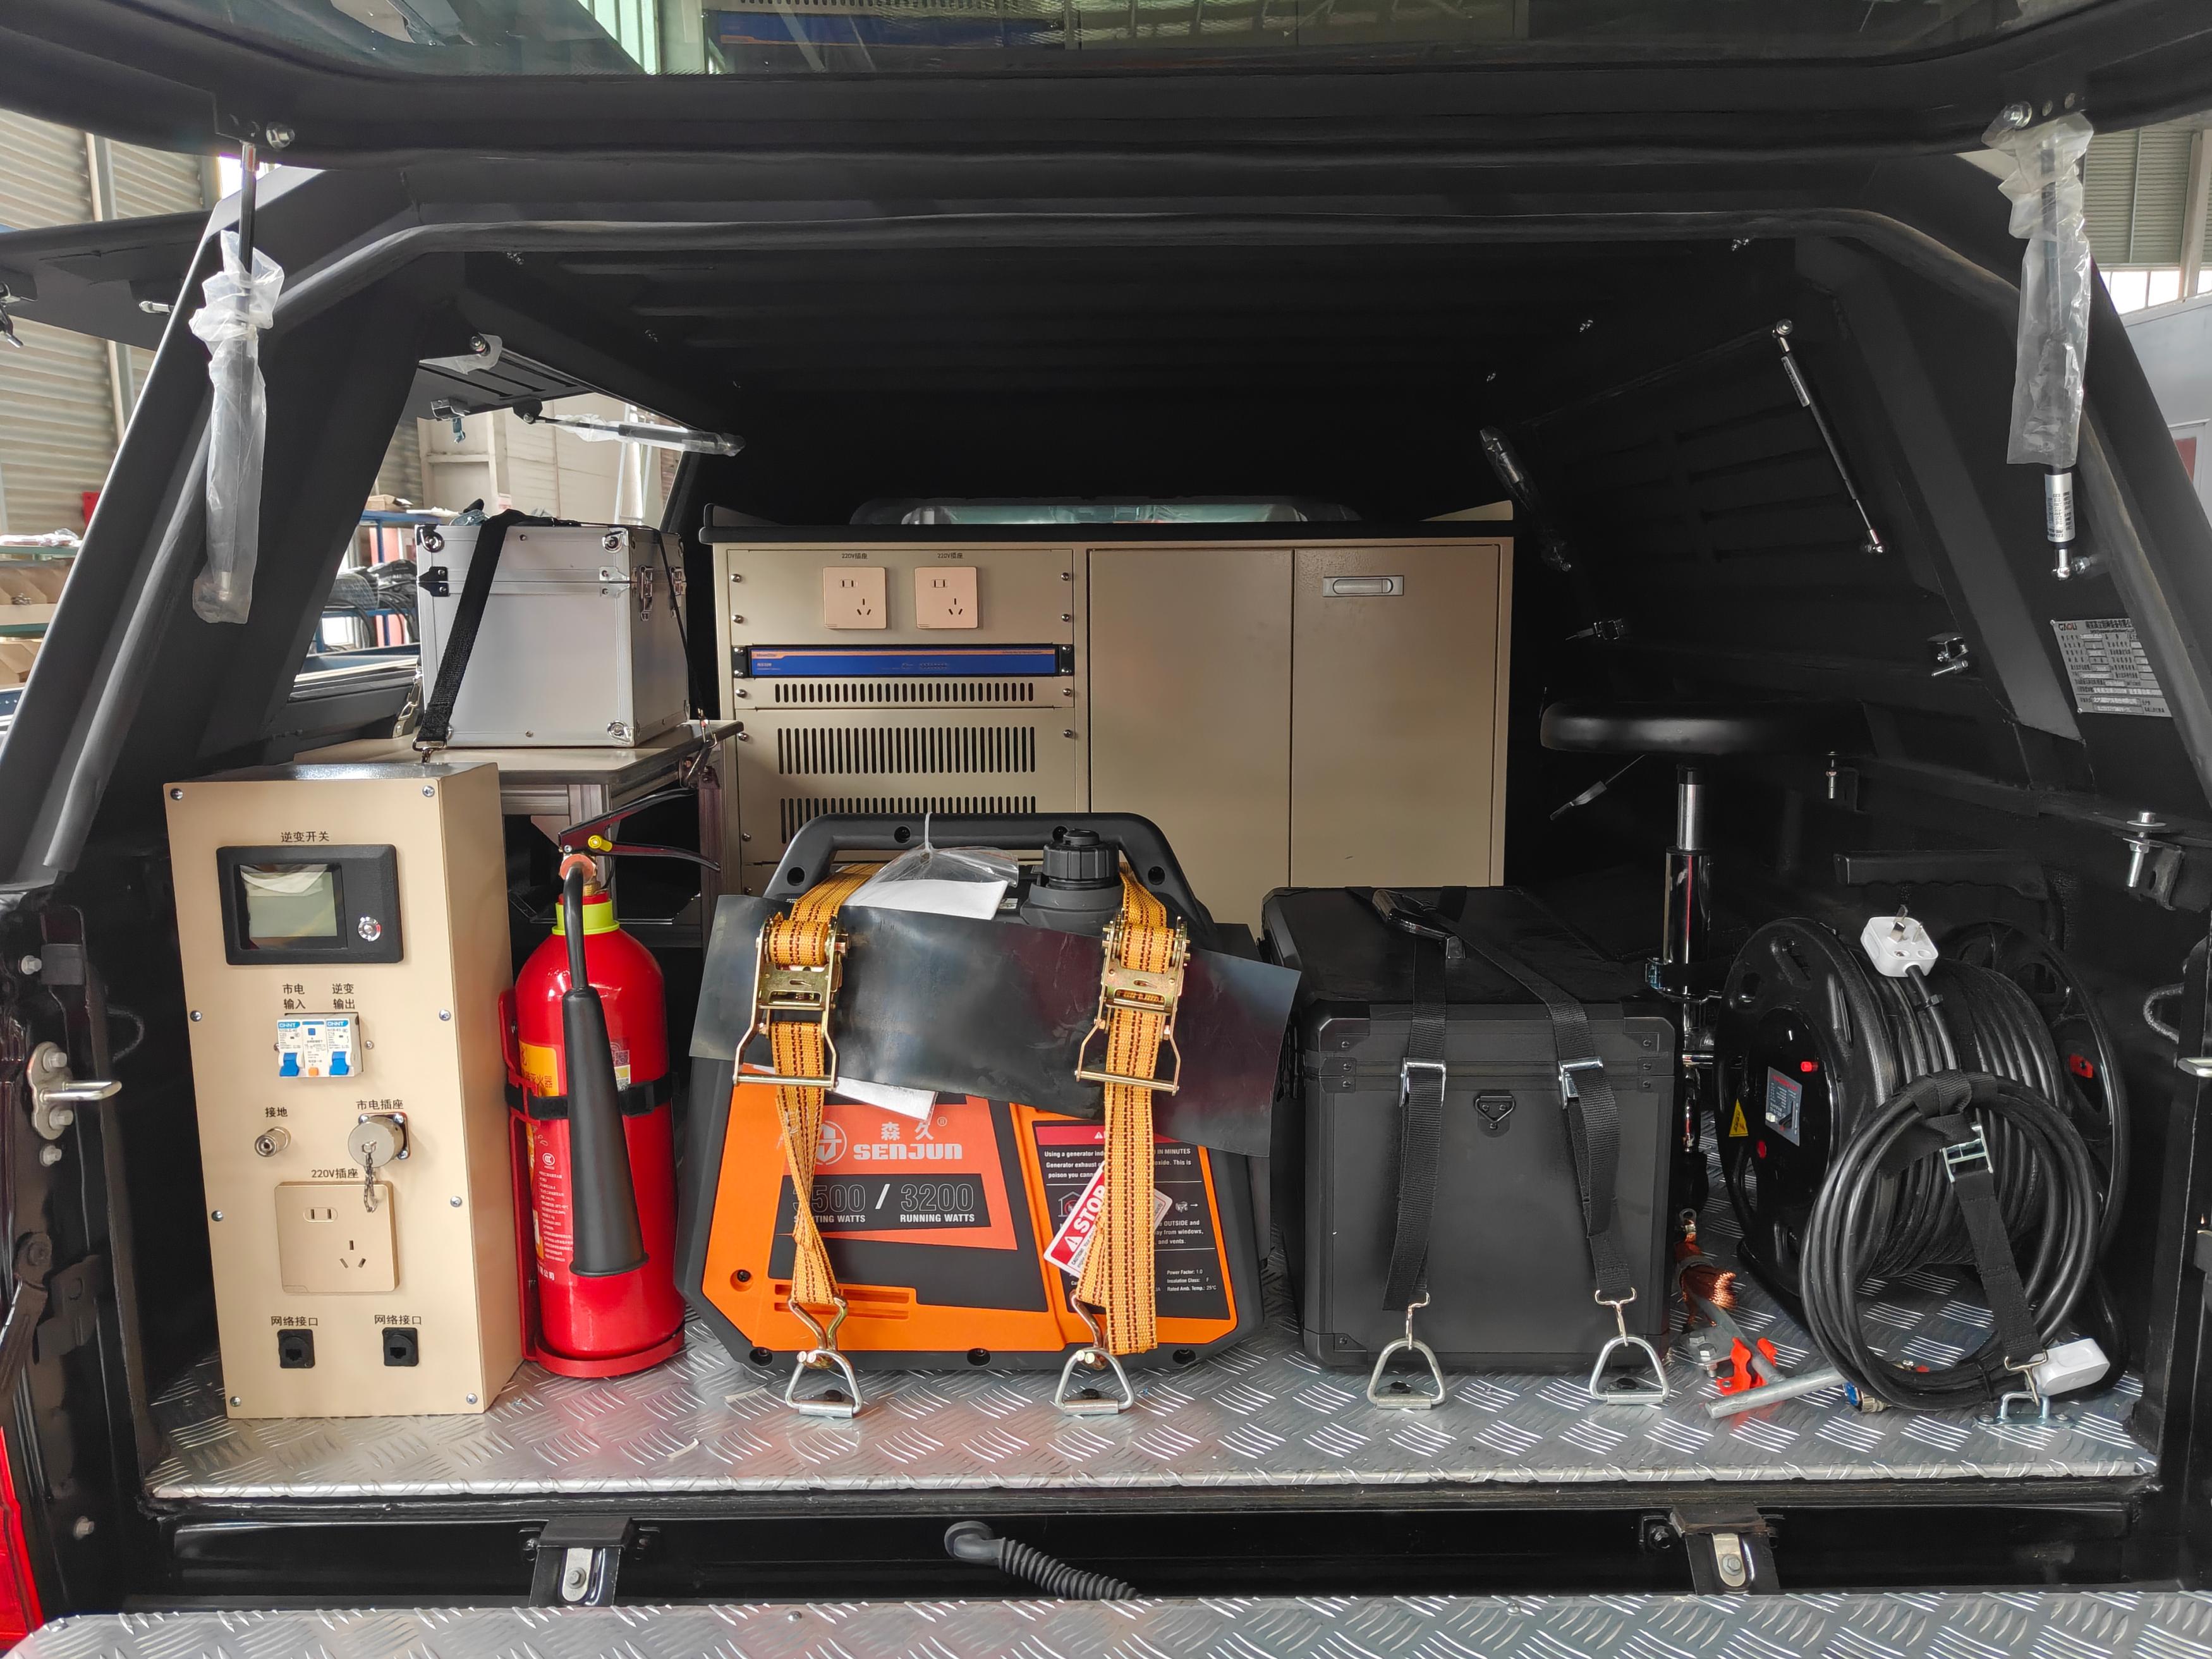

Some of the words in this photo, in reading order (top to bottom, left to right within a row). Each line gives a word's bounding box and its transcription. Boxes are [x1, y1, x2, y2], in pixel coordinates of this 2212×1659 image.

[280, 831, 330, 842] 逆变开关
[283, 983, 305, 995] 市电
[332, 983, 355, 995] 逆变
[283, 998, 306, 1010] 输入
[333, 997, 356, 1009] 输出
[356, 1099, 404, 1110] 市电插座
[265, 1107, 288, 1117] 接地
[881, 1122, 934, 1141] 森久
[853, 1143, 963, 1160] SENJUN
[311, 1168, 359, 1179] 220V插座
[901, 1184, 975, 1212] 3200
[900, 1214, 941, 1223] RUNNING
[944, 1213, 975, 1222] WATTS
[270, 1316, 319, 1327] 网络接口
[374, 1315, 422, 1326] 网络接口
